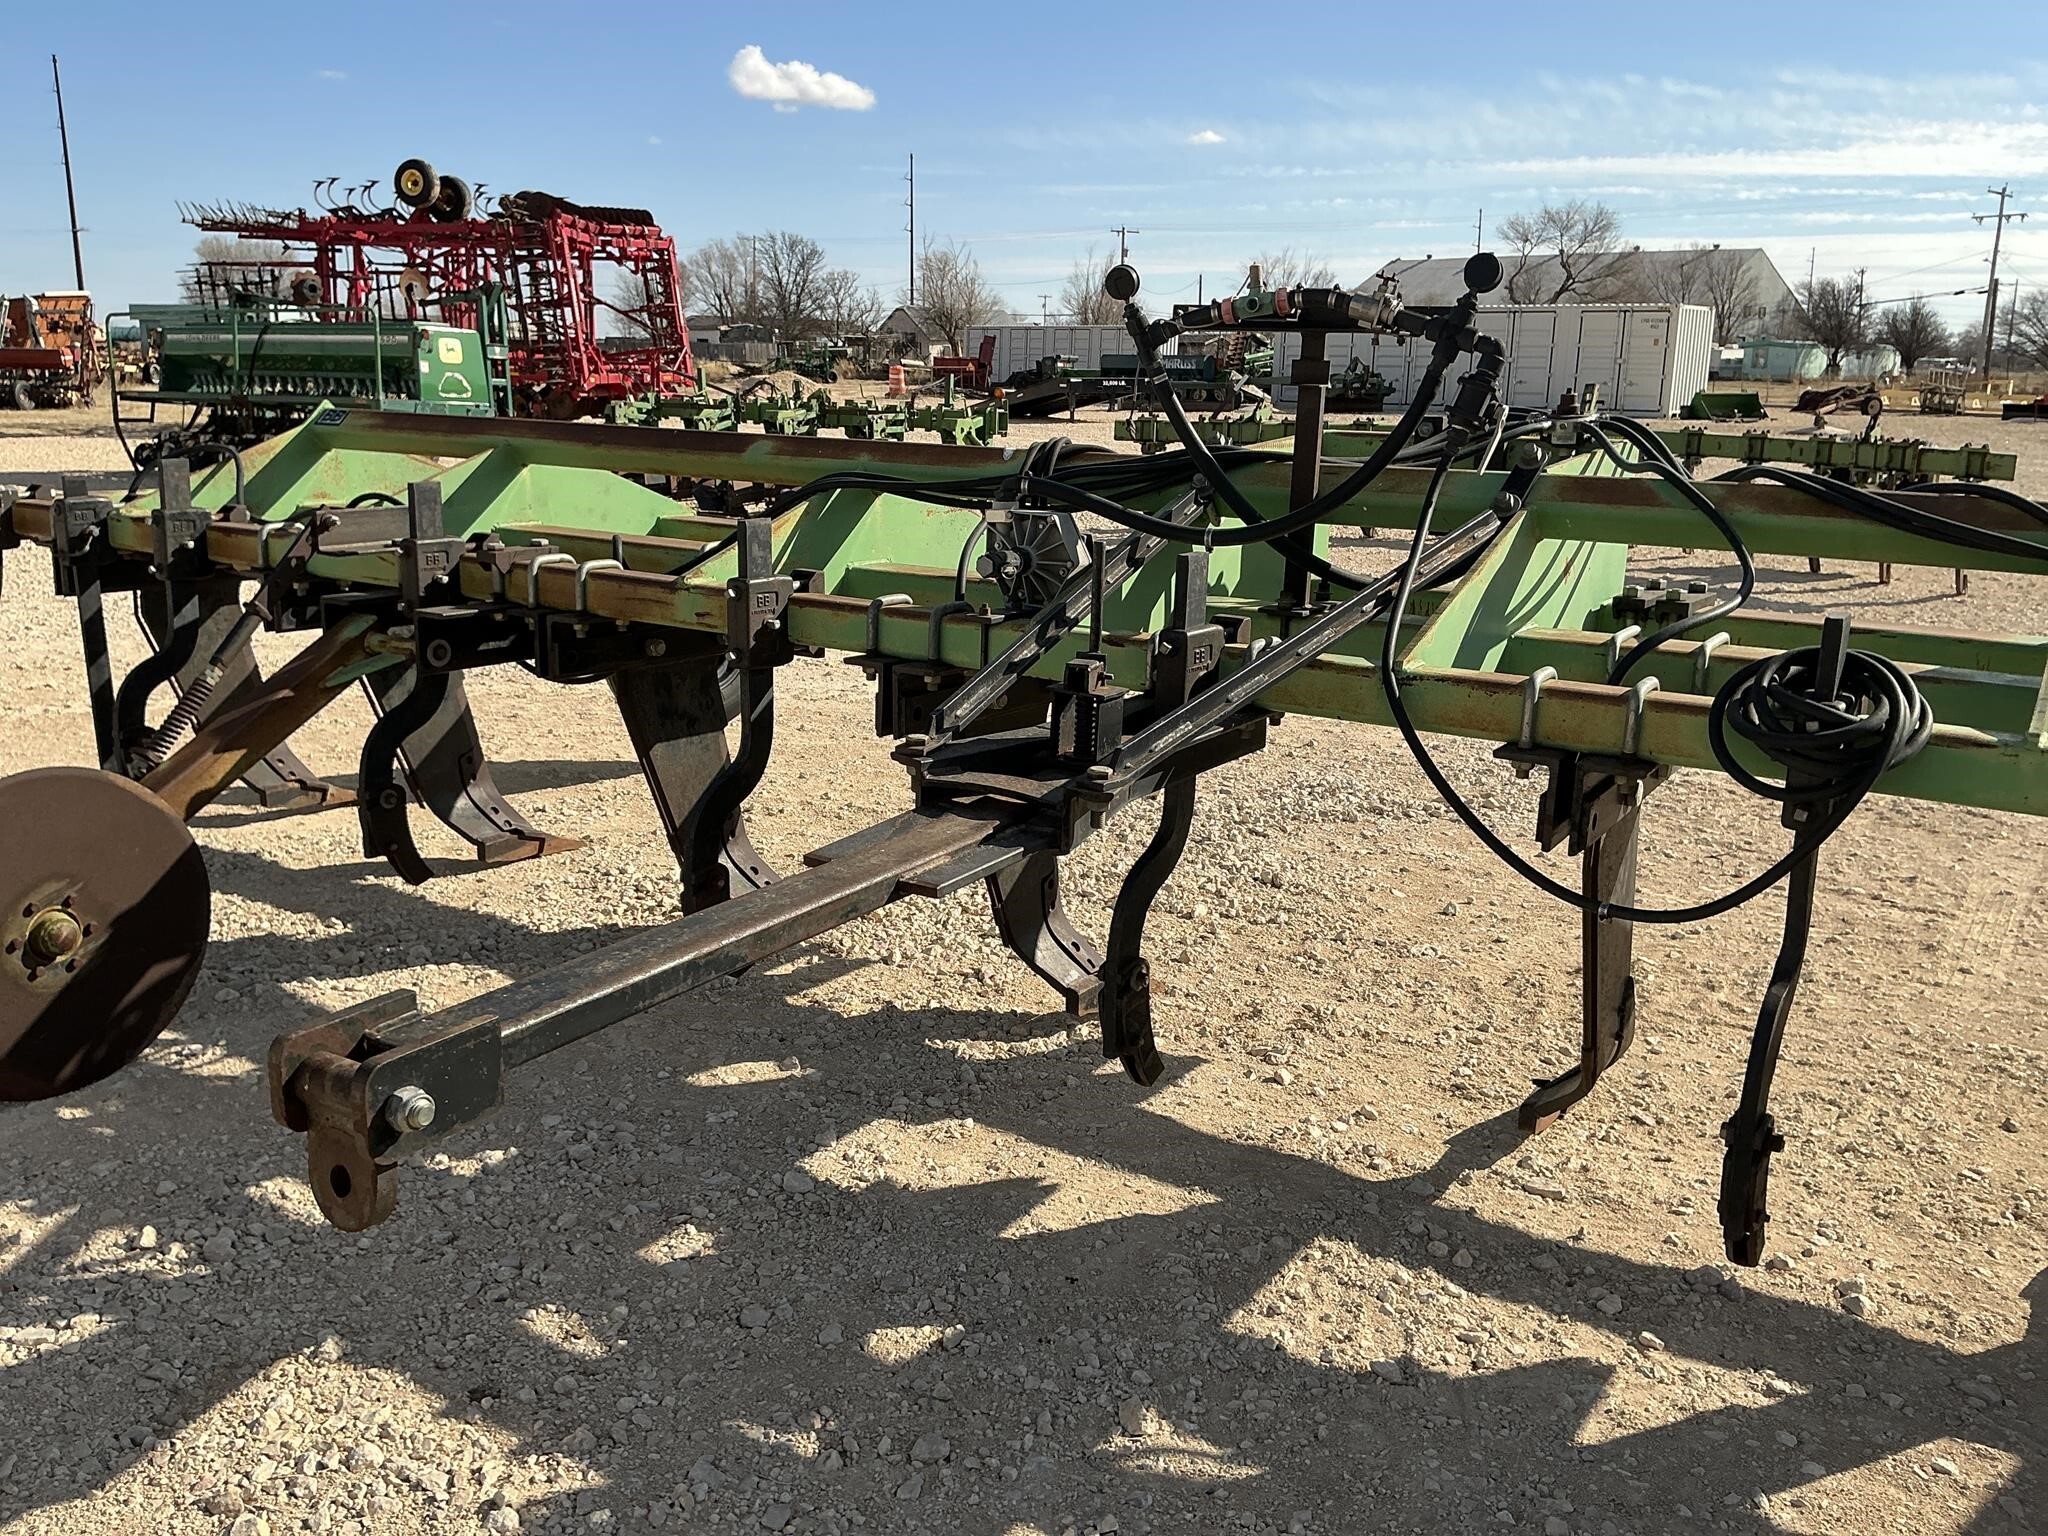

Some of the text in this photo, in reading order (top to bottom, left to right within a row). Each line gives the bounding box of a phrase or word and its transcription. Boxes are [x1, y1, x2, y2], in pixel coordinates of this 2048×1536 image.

[74, 510, 88, 521] BB
[425, 552, 440, 566] BB
[756, 593, 771, 608] BB
[1193, 647, 1206, 664] BB
